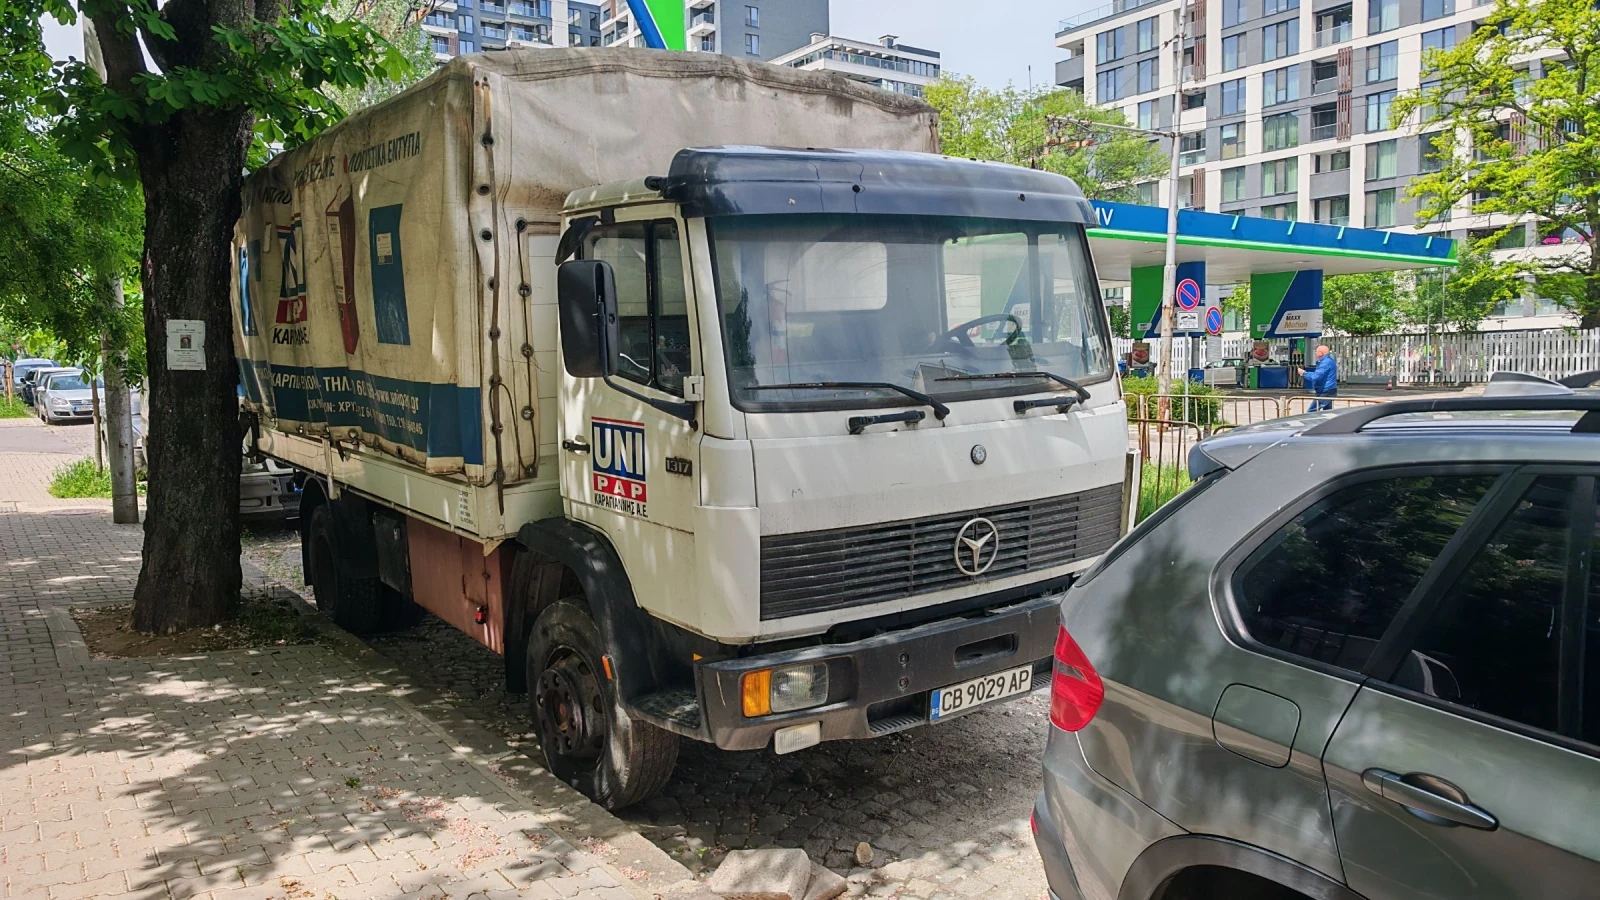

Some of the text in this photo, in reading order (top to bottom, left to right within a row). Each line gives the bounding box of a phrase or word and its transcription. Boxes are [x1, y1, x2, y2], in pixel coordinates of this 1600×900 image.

[388, 131, 420, 163] ΕΝΤΥΠΑ
[1284, 321, 1308, 329] Motion
[593, 426, 644, 476] UNI
[666, 459, 690, 474] 1317
[597, 475, 643, 499] PAP
[594, 493, 635, 515] ΚΑΡΑΓΙΑΝΝΗΣ
[942, 669, 1029, 712] CB 9029 AP
